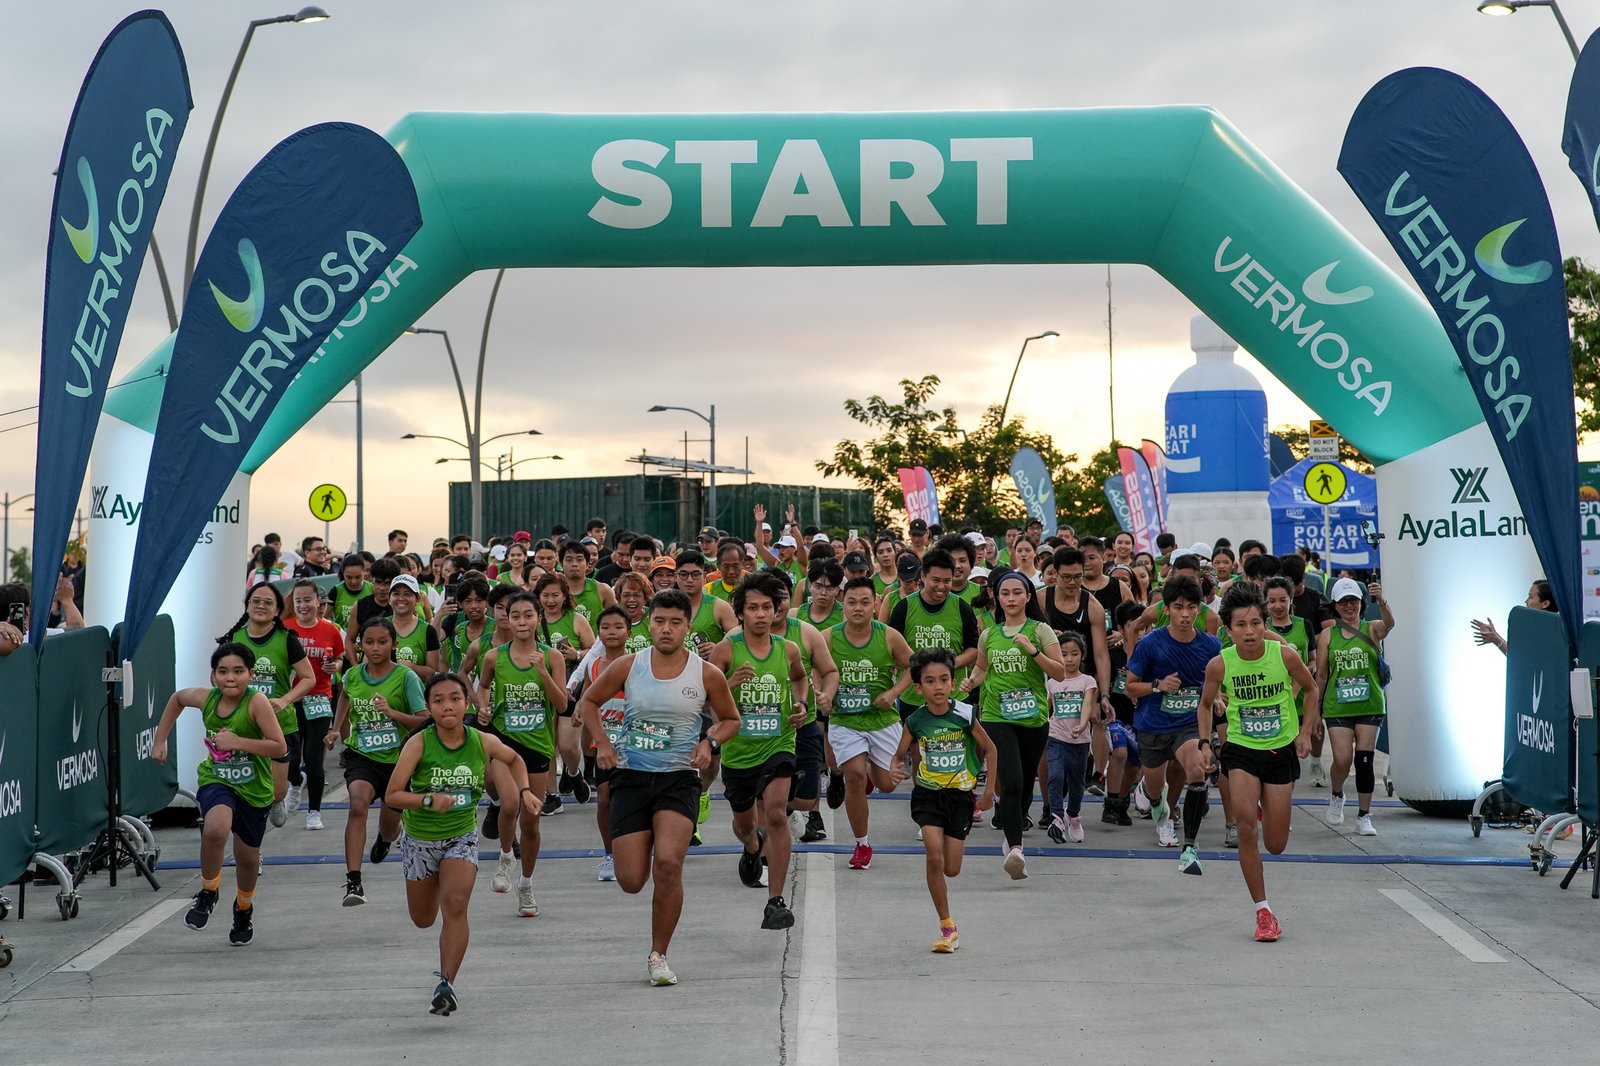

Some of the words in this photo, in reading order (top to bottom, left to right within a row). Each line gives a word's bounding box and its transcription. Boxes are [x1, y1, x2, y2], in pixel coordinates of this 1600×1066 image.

[587, 137, 1033, 229] START
[65, 108, 174, 398] VERMOSA
[1384, 170, 1532, 442] VERMOSA
[1214, 235, 1392, 417] VERMOSA
[200, 230, 387, 444] VERMOSA
[915, 638, 945, 648] Run
[993, 661, 1023, 673] Run
[1336, 659, 1364, 671] Run
[842, 671, 873, 682] Run
[1231, 674, 1257, 688] TAKBO
[505, 683, 522, 691] The
[1342, 687, 1367, 698] 3107
[352, 697, 368, 706] The
[740, 690, 776, 704] Run
[840, 698, 871, 708] 3070
[1005, 699, 1036, 712] 3040
[1057, 703, 1081, 713] 3221
[1166, 699, 1198, 709] 3054
[510, 713, 544, 726] 3076
[746, 718, 778, 731] 3159
[1245, 719, 1281, 732] 3084
[364, 732, 397, 747] 3081
[1516, 712, 1555, 754] VERMOSA
[635, 736, 665, 749] 3114
[931, 754, 965, 767] 3087
[56, 748, 98, 791] VERMOSA
[217, 766, 252, 779] 3100
[431, 767, 452, 777] The
